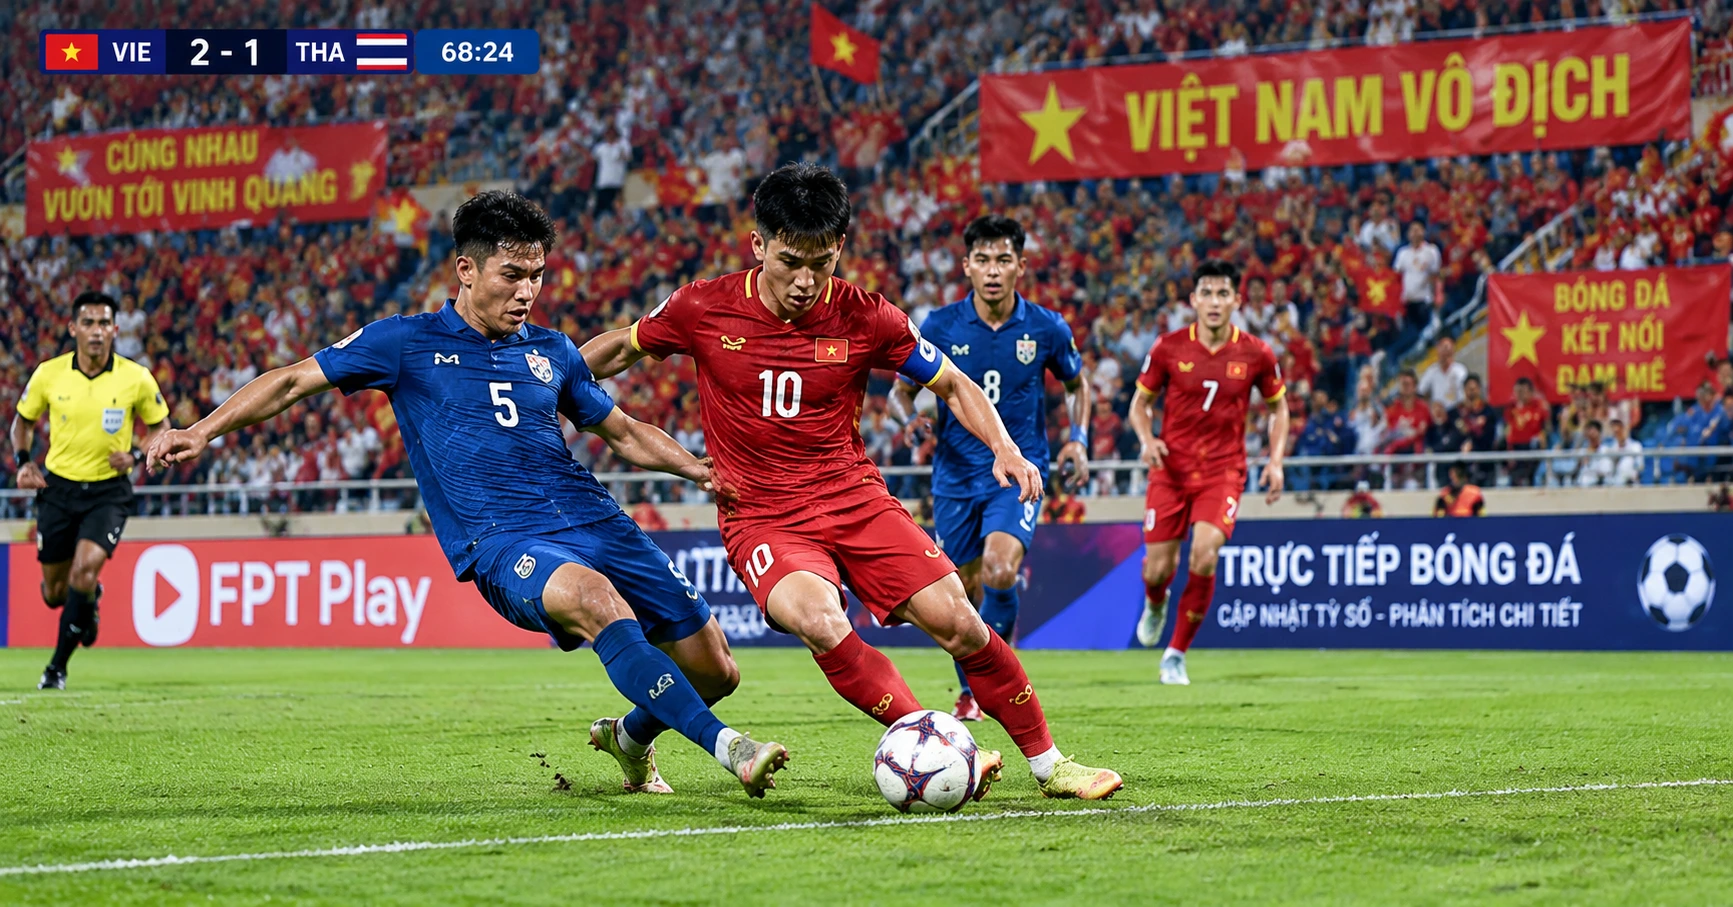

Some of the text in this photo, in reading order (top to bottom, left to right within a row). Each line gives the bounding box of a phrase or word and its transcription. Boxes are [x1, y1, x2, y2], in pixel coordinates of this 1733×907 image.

[1124, 52, 1630, 163] VIỆT NAM VÔ ĐỊCH
[184, 130, 260, 169] NHAU
[171, 176, 237, 215] VINH
[243, 168, 338, 214] QUANG
[1554, 275, 1627, 313] BÓNG
[1561, 312, 1664, 354] KẾT NỐI
[488, 382, 519, 428] 5
[758, 369, 803, 418] 10
[983, 369, 1001, 404] 8
[1202, 380, 1219, 412] 7
[745, 543, 775, 588] 10
[1218, 530, 1582, 594] TRỰC TIẾP BÓNG ĐÁ
[209, 558, 432, 644] FPT Play
[1499, 602, 1535, 628] CHI
[1539, 595, 1583, 628] TIẾT
